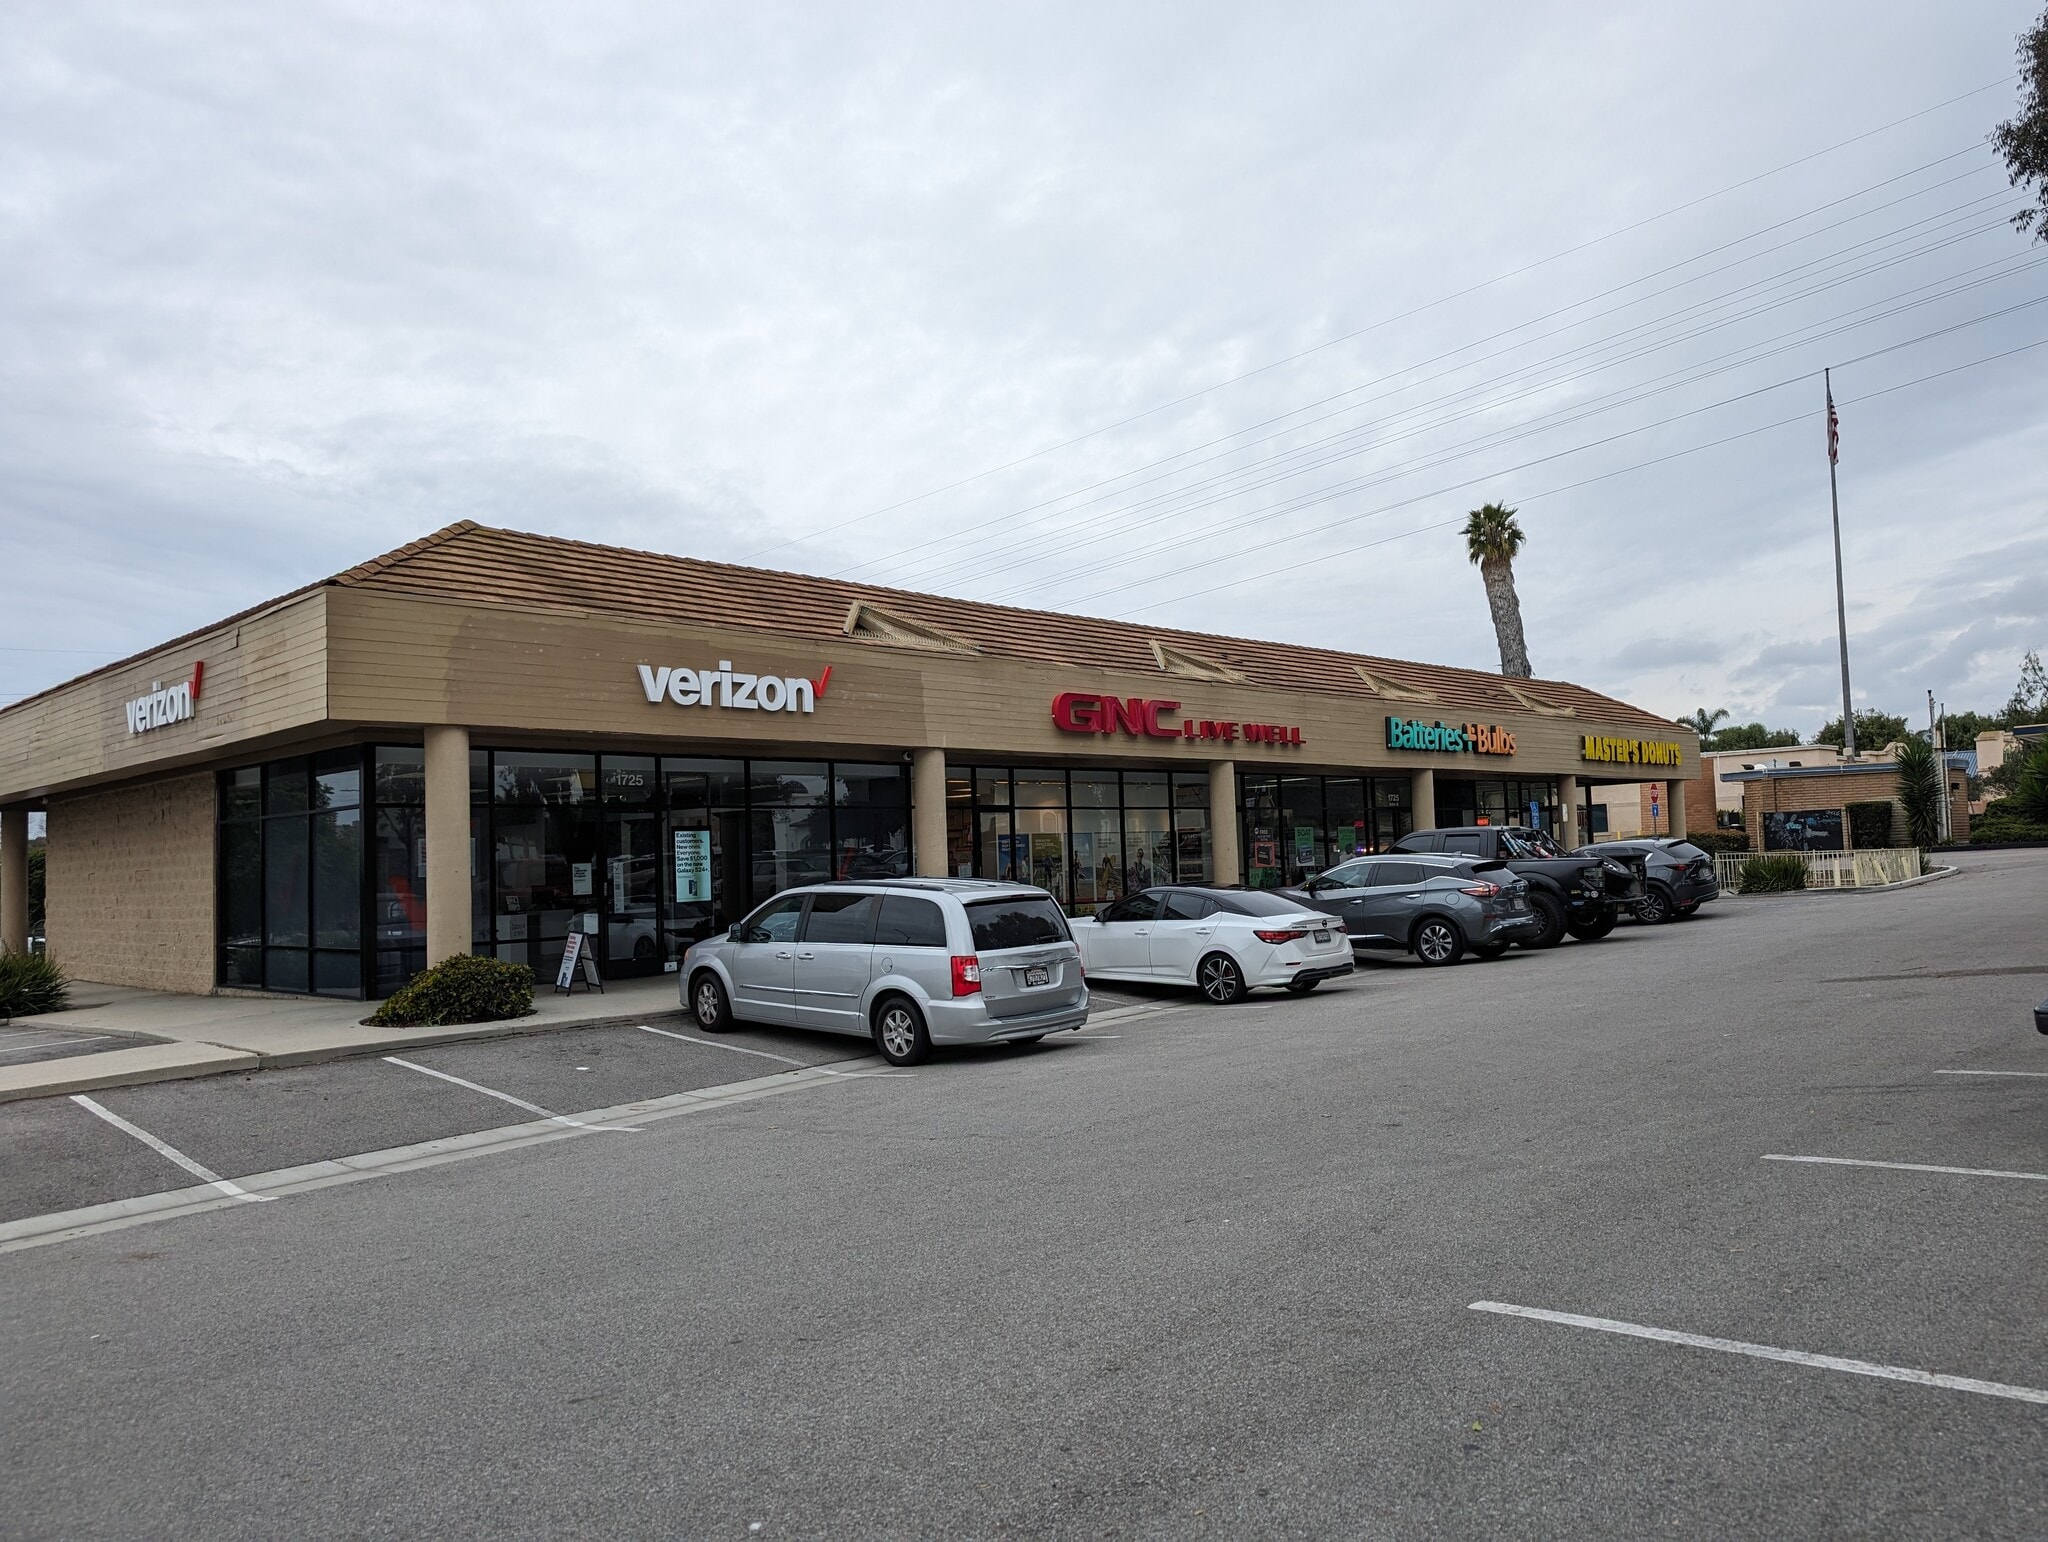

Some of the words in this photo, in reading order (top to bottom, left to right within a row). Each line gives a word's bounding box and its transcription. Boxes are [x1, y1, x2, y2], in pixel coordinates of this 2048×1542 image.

[126, 681, 194, 734] verizon
[637, 660, 814, 713] verizon
[1051, 692, 1182, 737] GNC
[1184, 719, 1240, 741] LIVE
[1242, 723, 1307, 745] WELL
[1583, 735, 1639, 764] MASTER'S
[1641, 741, 1682, 766] DONUTS
[616, 774, 644, 786] 1725
[1387, 794, 1400, 802] 1725
